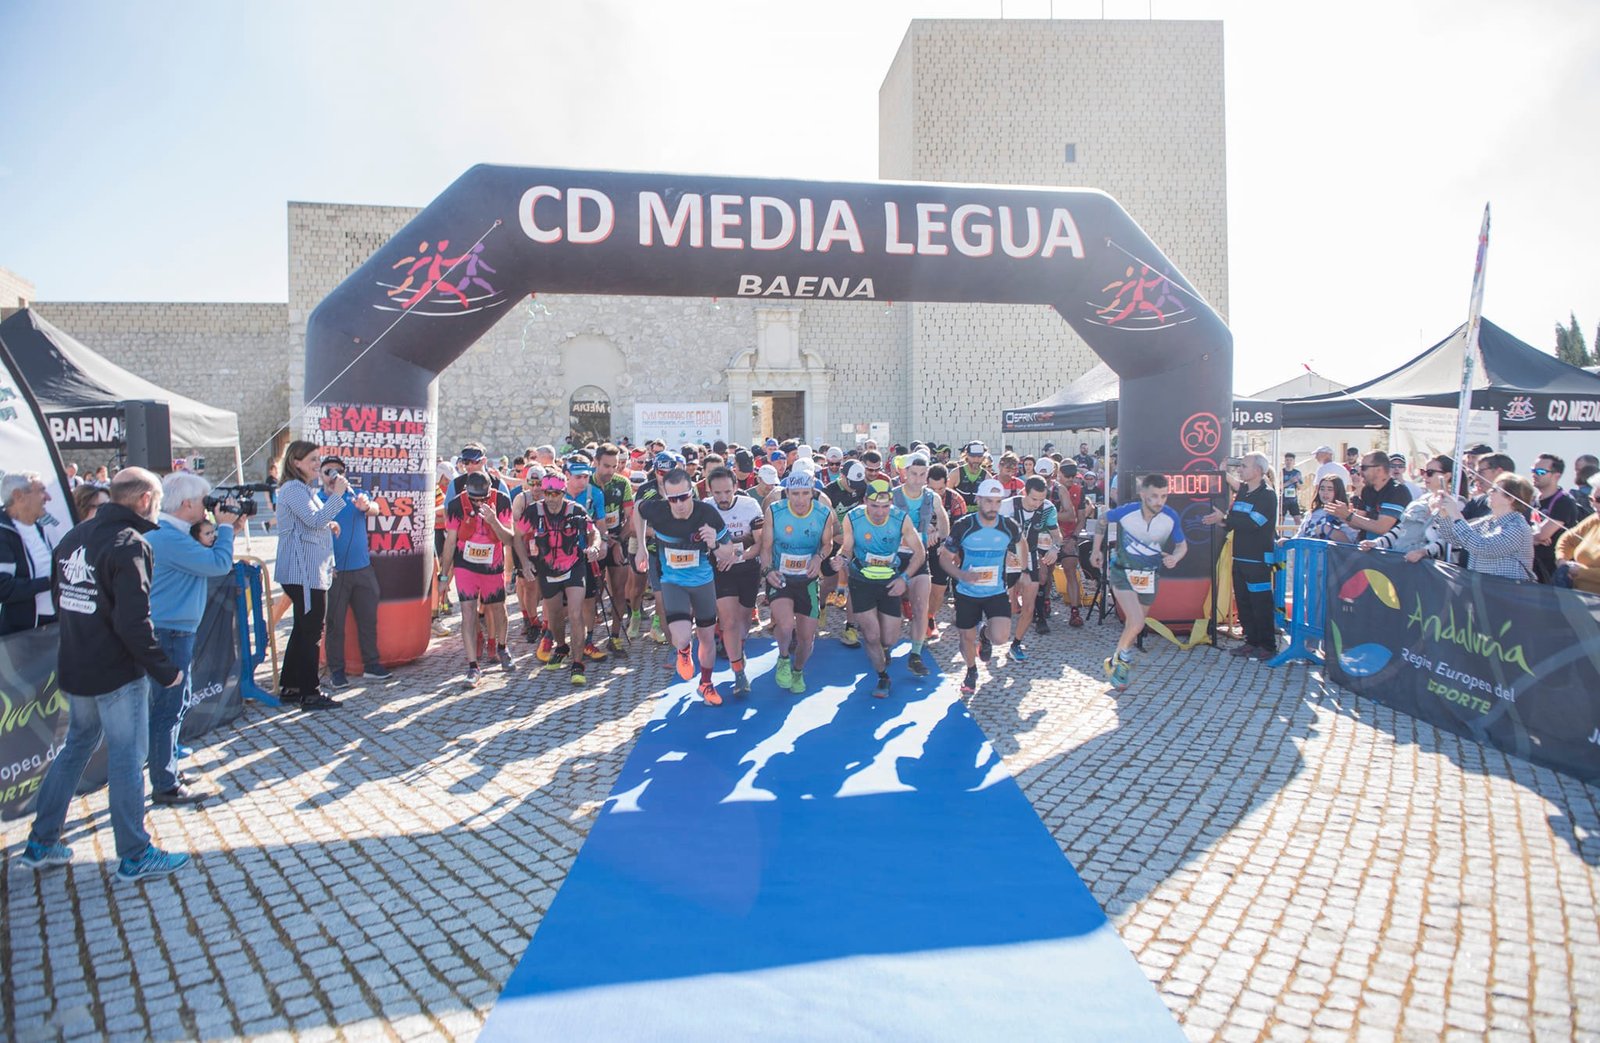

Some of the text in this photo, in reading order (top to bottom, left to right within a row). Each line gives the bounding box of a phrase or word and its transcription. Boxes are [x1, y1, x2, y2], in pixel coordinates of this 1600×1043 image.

[518, 185, 1085, 259] CD MEDIA LEGUA
[737, 274, 876, 298] BAENA
[1548, 400, 1600, 422] CD MEDI
[49, 417, 119, 441] BAENA
[320, 417, 424, 434] SILVESTRE
[676, 555, 688, 563] 51
[790, 560, 801, 568] 86
[1435, 661, 1492, 694] Europea
[1494, 683, 1516, 703] del
